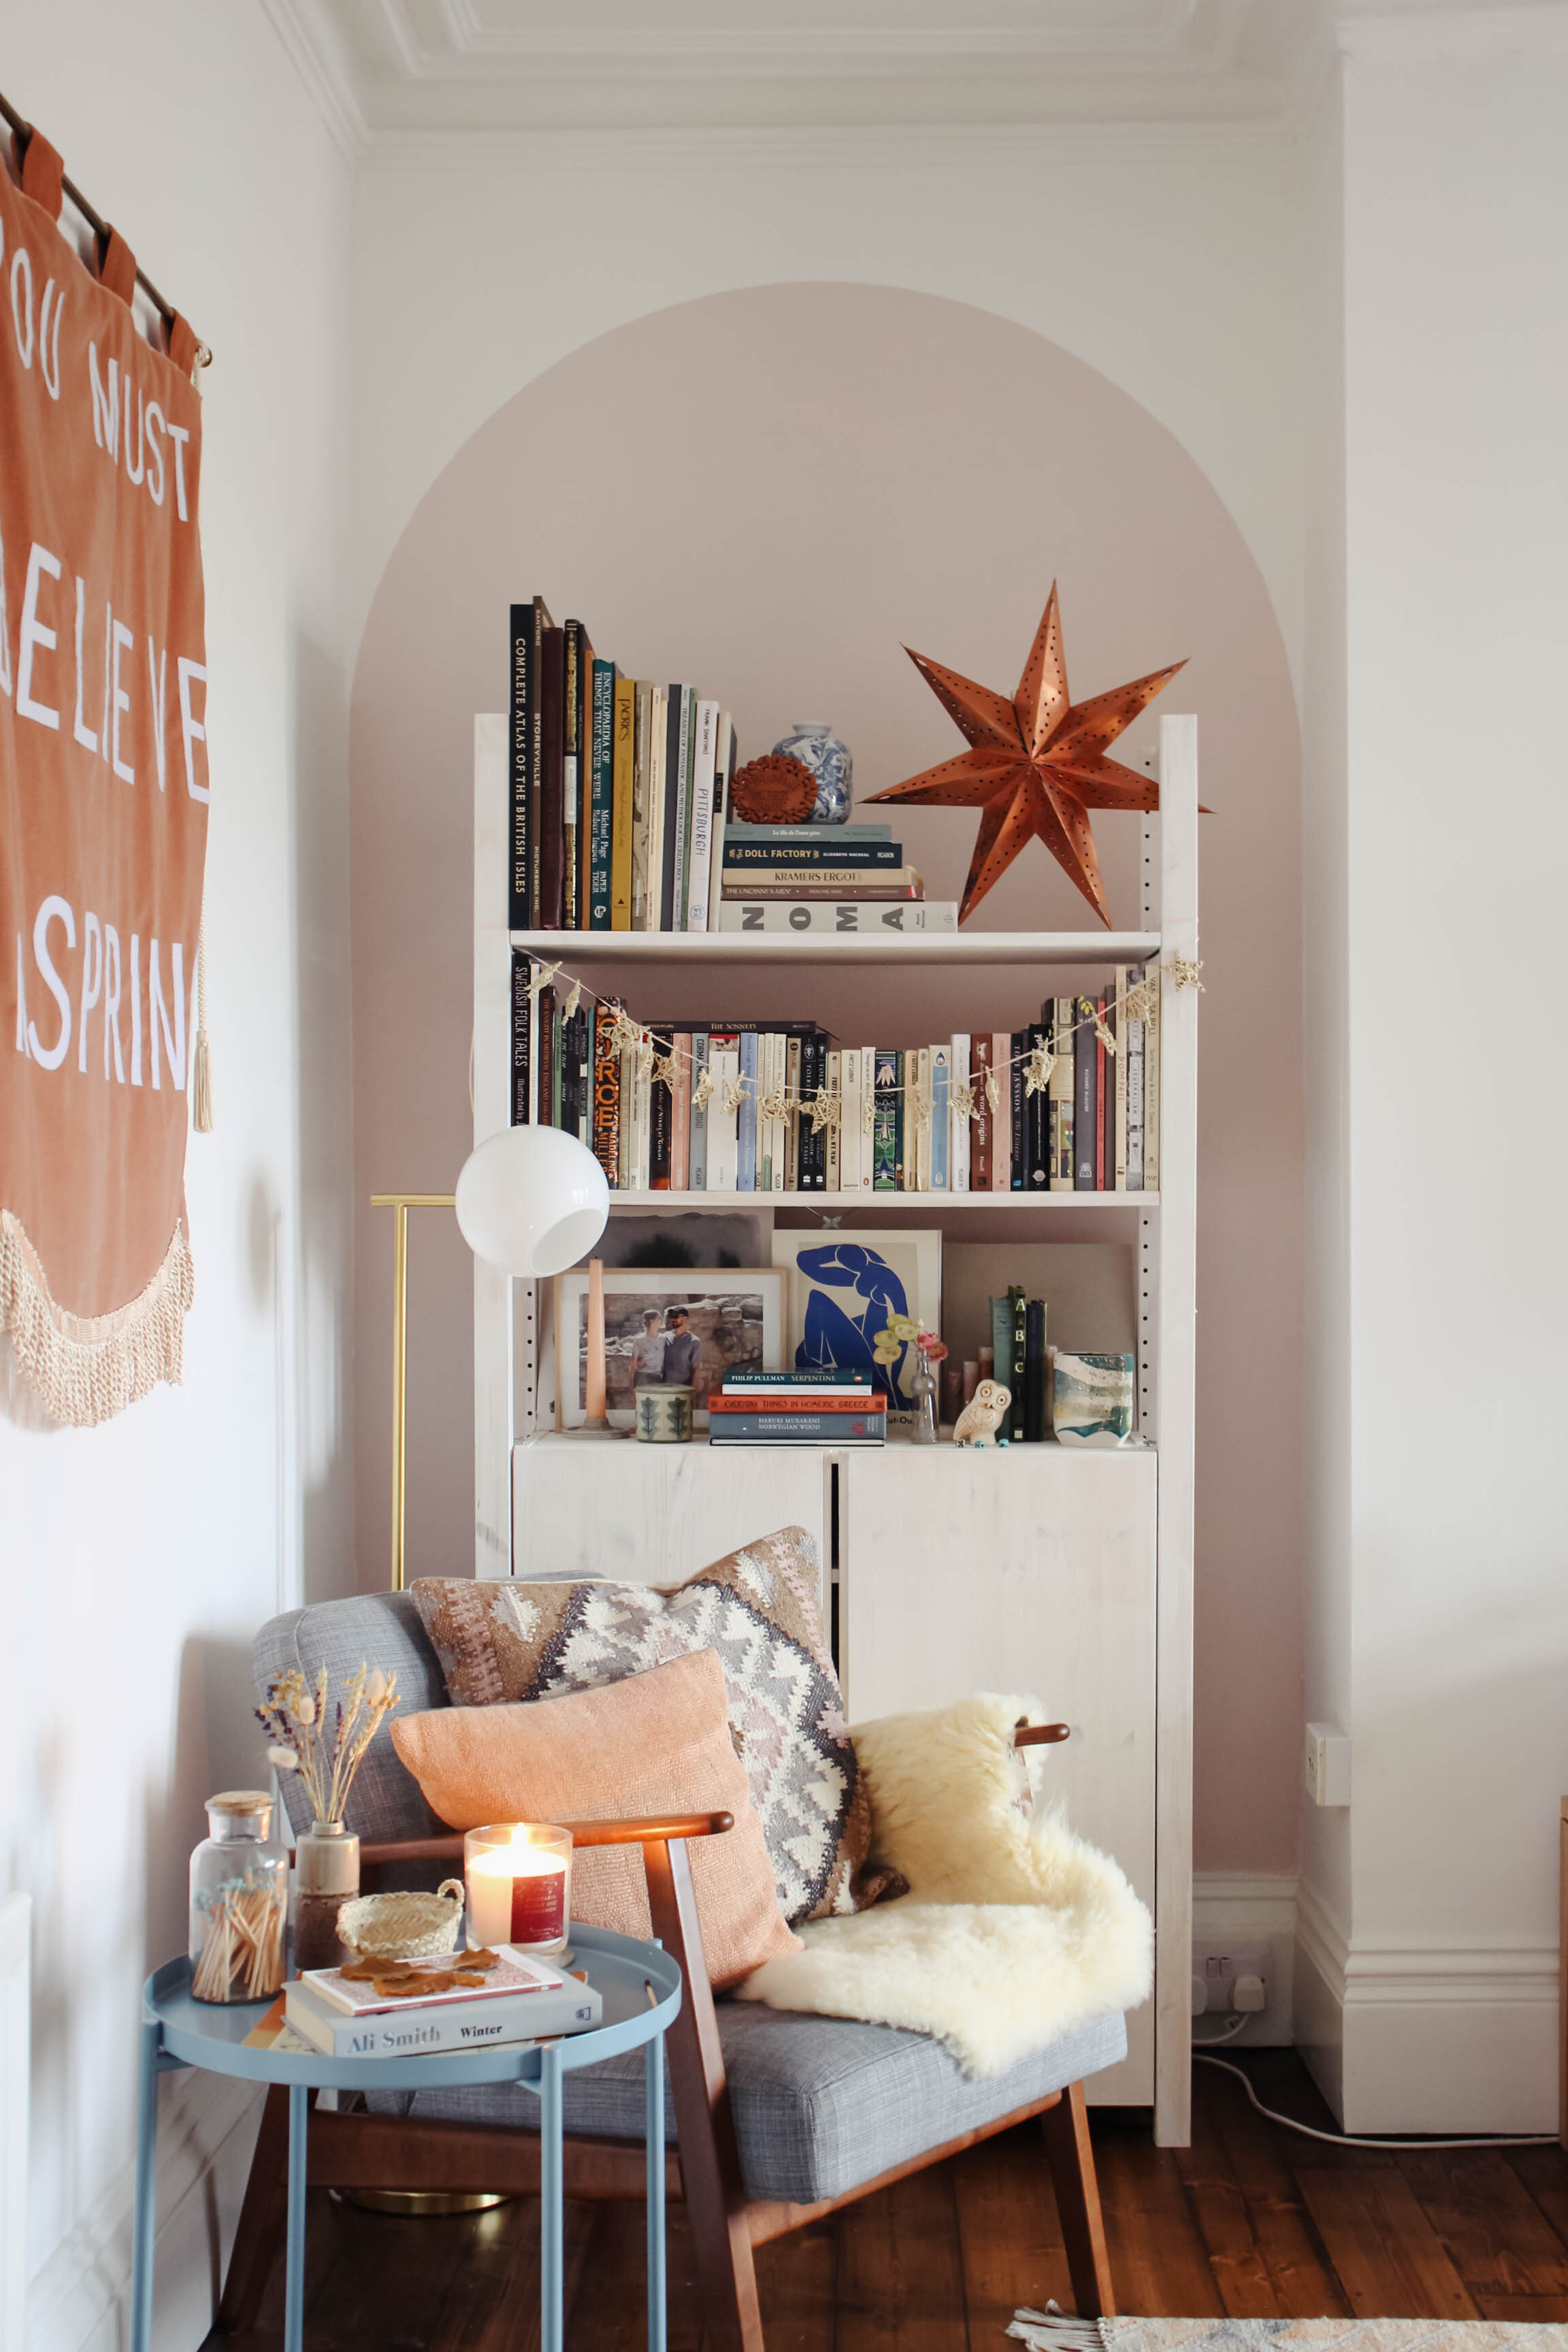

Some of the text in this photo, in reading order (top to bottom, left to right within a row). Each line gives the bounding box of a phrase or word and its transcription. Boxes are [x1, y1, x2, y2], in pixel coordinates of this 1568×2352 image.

[0, 218, 189, 522] OU MUST
[602, 672, 612, 764] ENCYCLOPAEDIA OF
[592, 672, 603, 800] THINGS THAT NEVER WERE
[515, 638, 526, 894] COMPLETE ATLAS OF THE BRITISH ISLES
[592, 809, 600, 834] Robert
[599, 809, 609, 858] Michael Page
[694, 788, 708, 855] PITTSBURGH
[771, 849, 811, 858] FACTORY
[591, 871, 600, 893] TIGER
[599, 871, 607, 893] PAPER
[774, 872, 856, 881] KRAMERS ERGOT
[515, 966, 527, 1007] SWEDISH
[514, 1009, 527, 1033] FOLK
[514, 1037, 527, 1067] TALES
[1013, 1073, 1022, 1112] JANSSON
[516, 1111, 525, 1120] by
[978, 1118, 986, 1145] origins
[608, 1132, 617, 1173] MADELINE
[723, 1401, 757, 1409] EVERYDAY
[800, 1401, 834, 1409] HOMERIC
[838, 1401, 868, 1409] GREECE
[886, 1416, 915, 1424] ut-Ou
[347, 2024, 503, 2053] Ali Smith Winter
